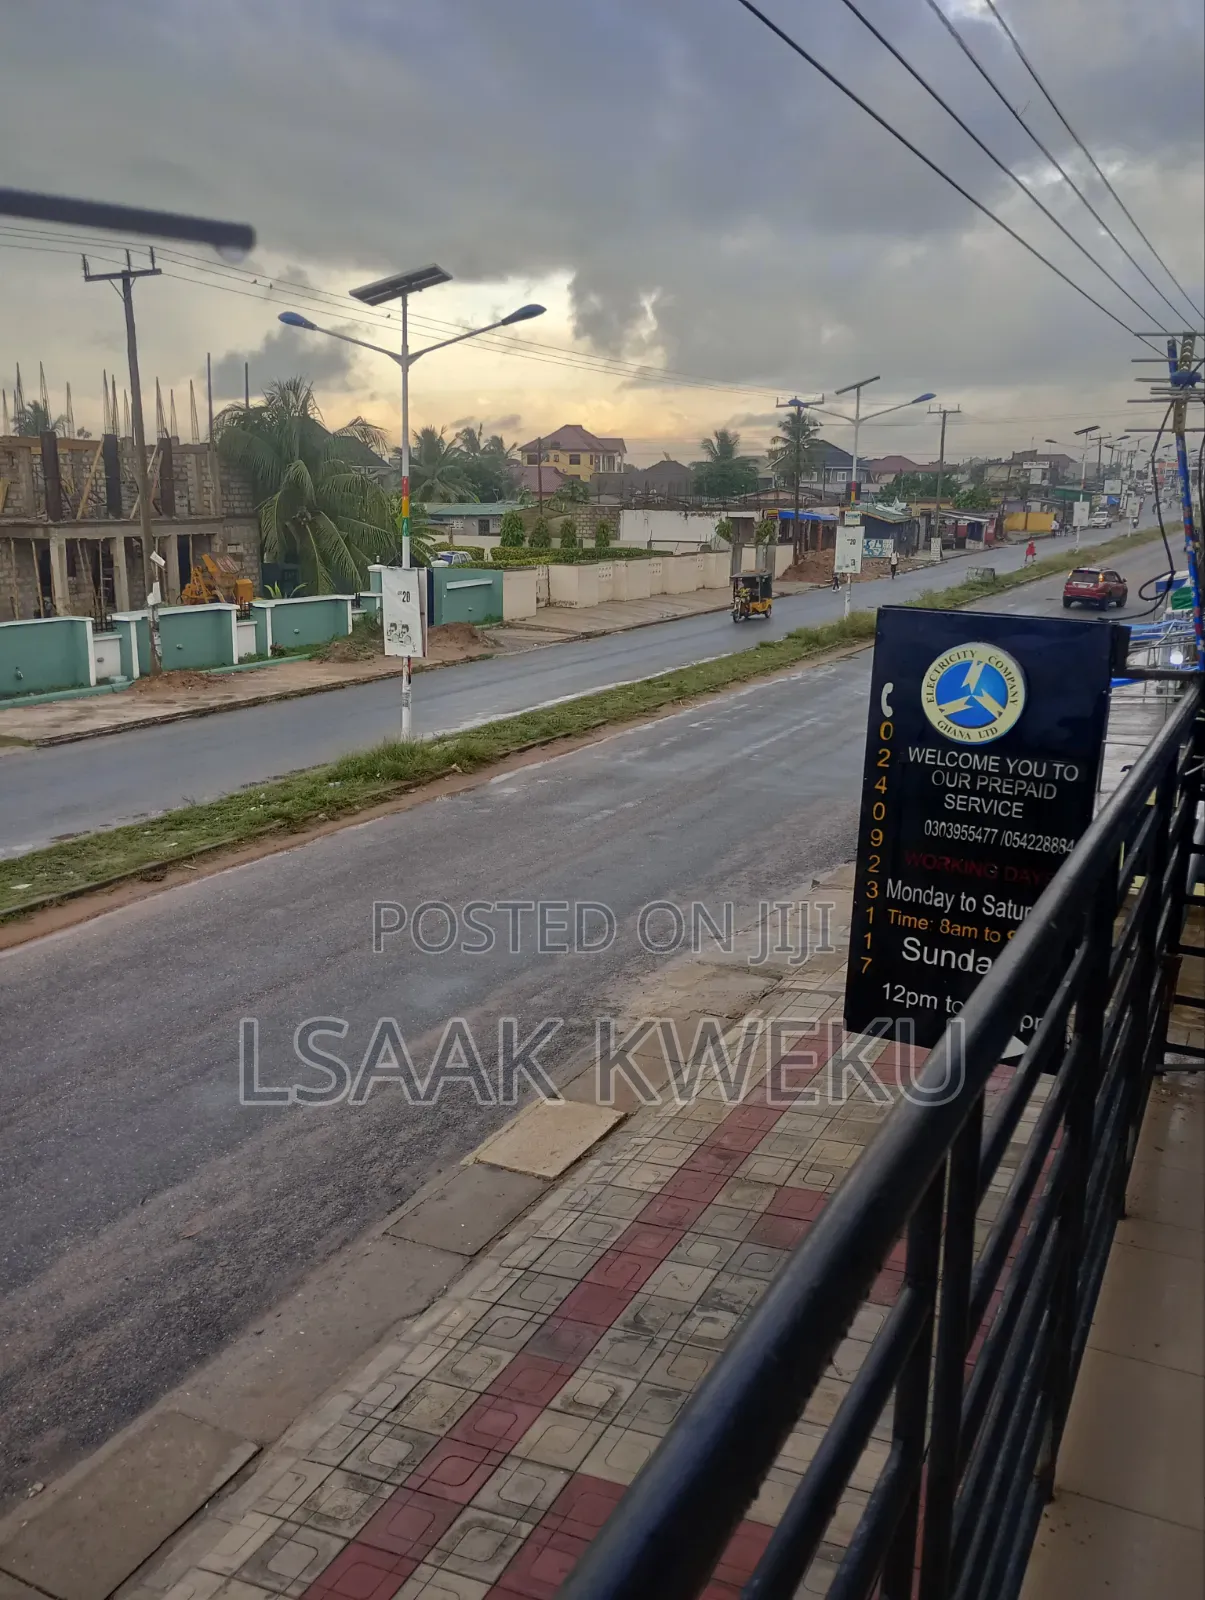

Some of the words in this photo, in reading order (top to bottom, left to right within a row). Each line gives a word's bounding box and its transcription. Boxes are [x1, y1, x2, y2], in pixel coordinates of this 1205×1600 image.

[926, 649, 977, 704] ELECTRICITY
[987, 654, 1019, 706] COMPANY
[937, 719, 972, 740] GHANA
[978, 725, 998, 740] LTD
[908, 746, 1000, 773] WELCOME
[1006, 757, 1047, 778] YOU
[1052, 763, 1079, 782] TO
[931, 769, 971, 790] OUR
[976, 775, 1058, 800] PREPAID
[943, 794, 1024, 819] SERVICE
[924, 819, 999, 845] 0303955477
[904, 850, 998, 879] WORKING
[886, 878, 955, 914] Monday
[960, 891, 977, 913] to
[982, 894, 1032, 921] Satur
[887, 908, 934, 931] Time:
[939, 918, 978, 939] 8am
[984, 926, 1001, 943] to
[902, 936, 992, 975] Sunda
[882, 982, 938, 1010] 12pm
[945, 995, 965, 1014] to
